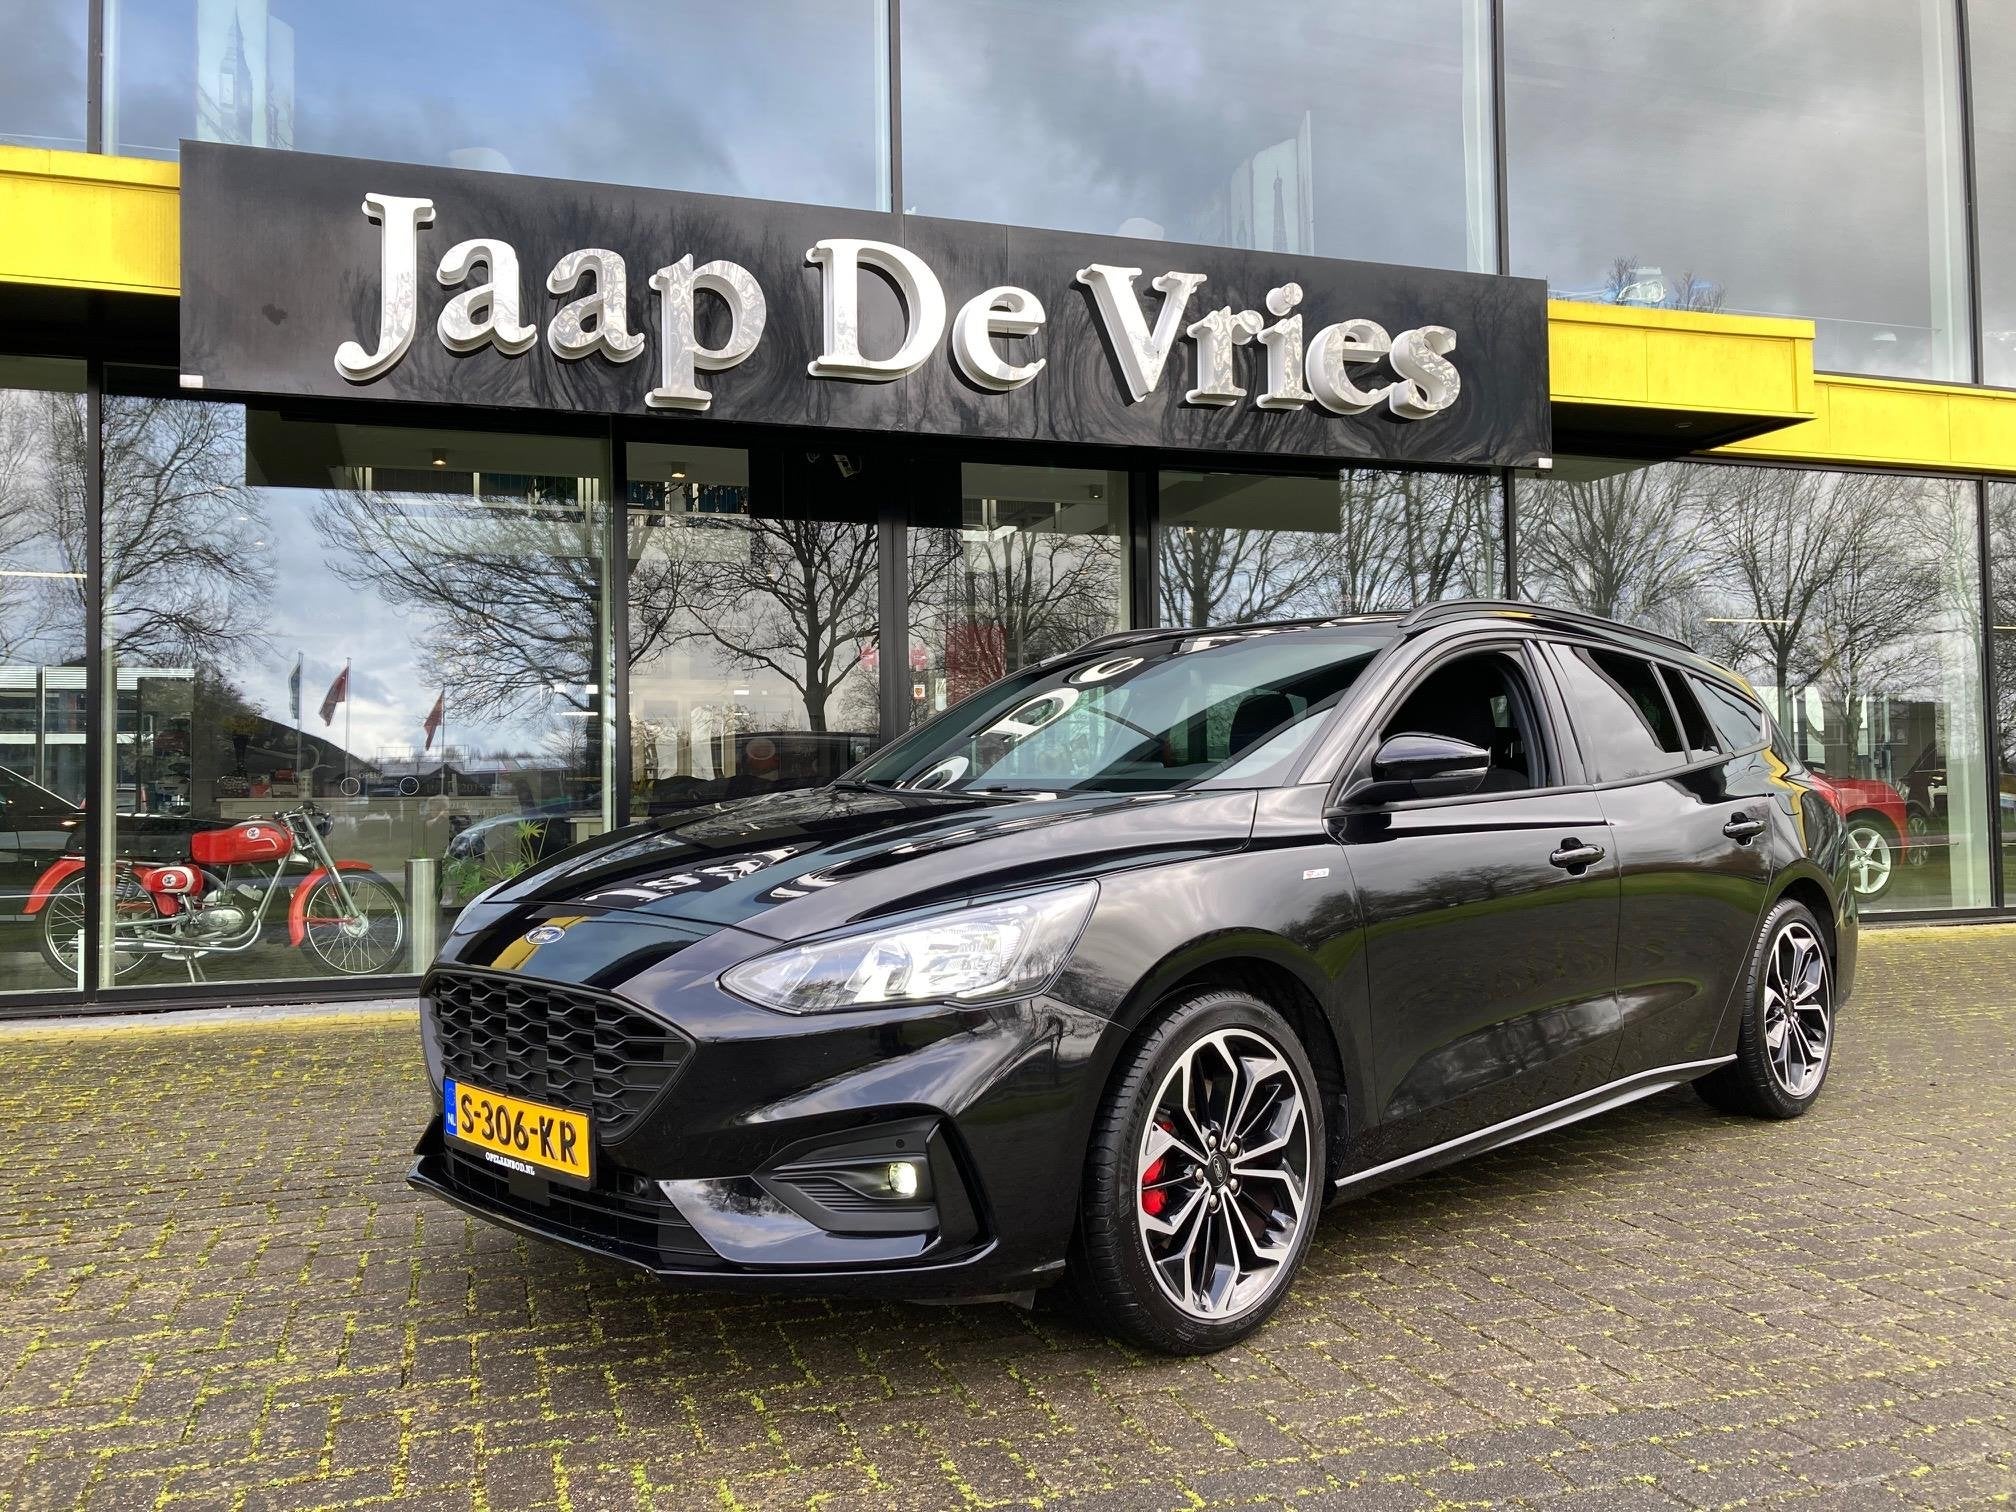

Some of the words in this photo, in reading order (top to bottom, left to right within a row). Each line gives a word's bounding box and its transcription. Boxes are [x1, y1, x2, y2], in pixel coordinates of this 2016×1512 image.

[334, 191, 768, 411] Jaap
[804, 238, 1047, 392] De
[1075, 263, 1462, 420] Vries
[447, 1112, 457, 1127] NL
[461, 1093, 579, 1166] S-306-KR
